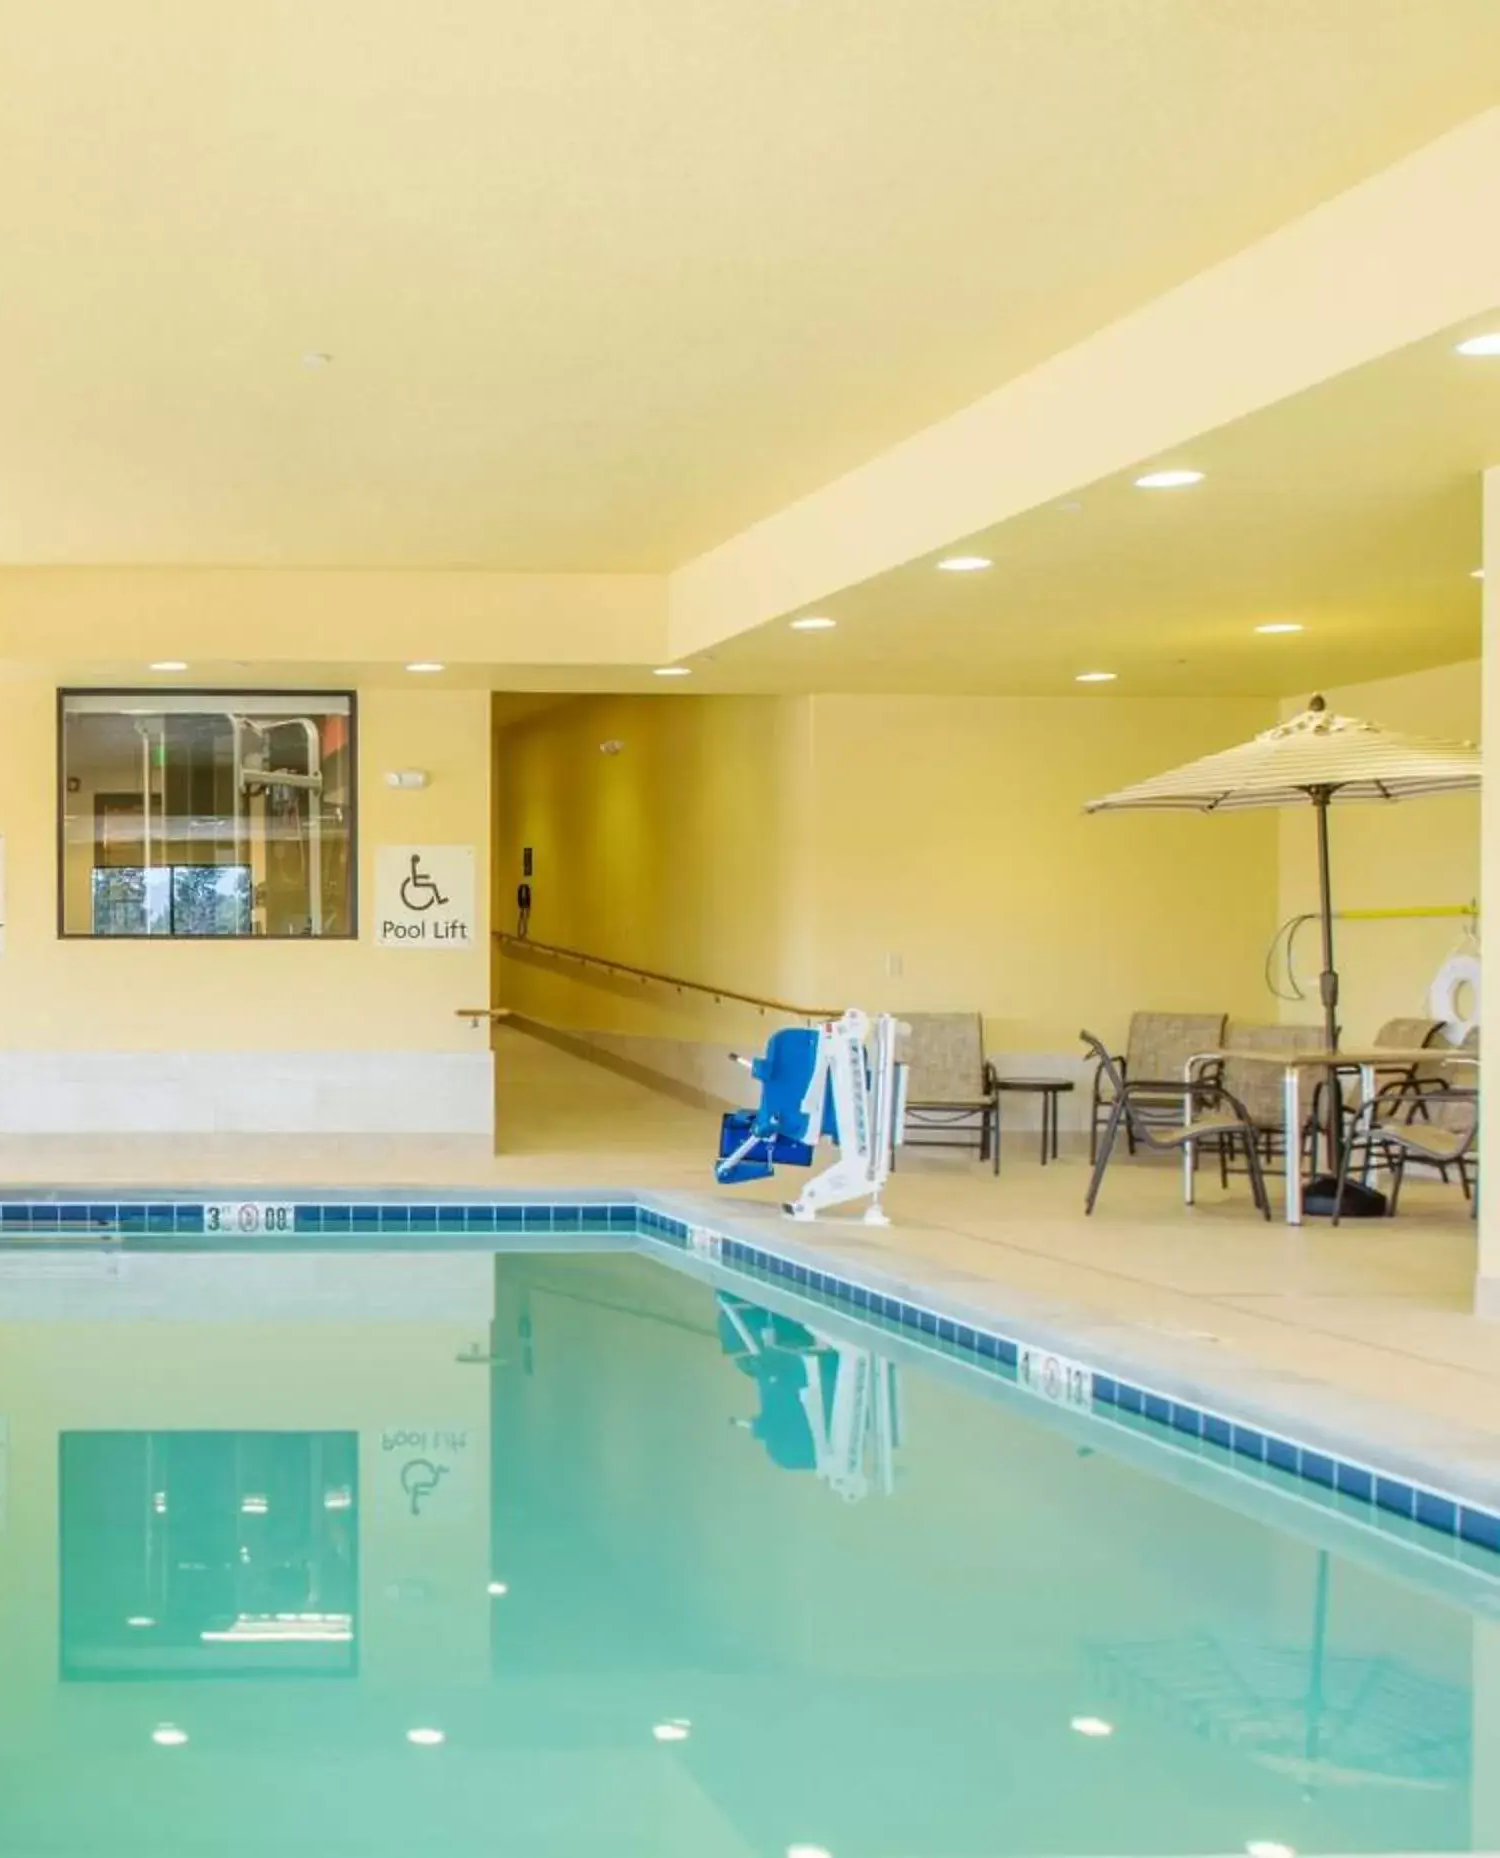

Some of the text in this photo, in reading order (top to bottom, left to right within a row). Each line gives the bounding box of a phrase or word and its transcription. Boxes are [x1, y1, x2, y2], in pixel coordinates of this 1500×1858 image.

[382, 920, 468, 939] Pool Lift
[207, 1206, 220, 1231] 3
